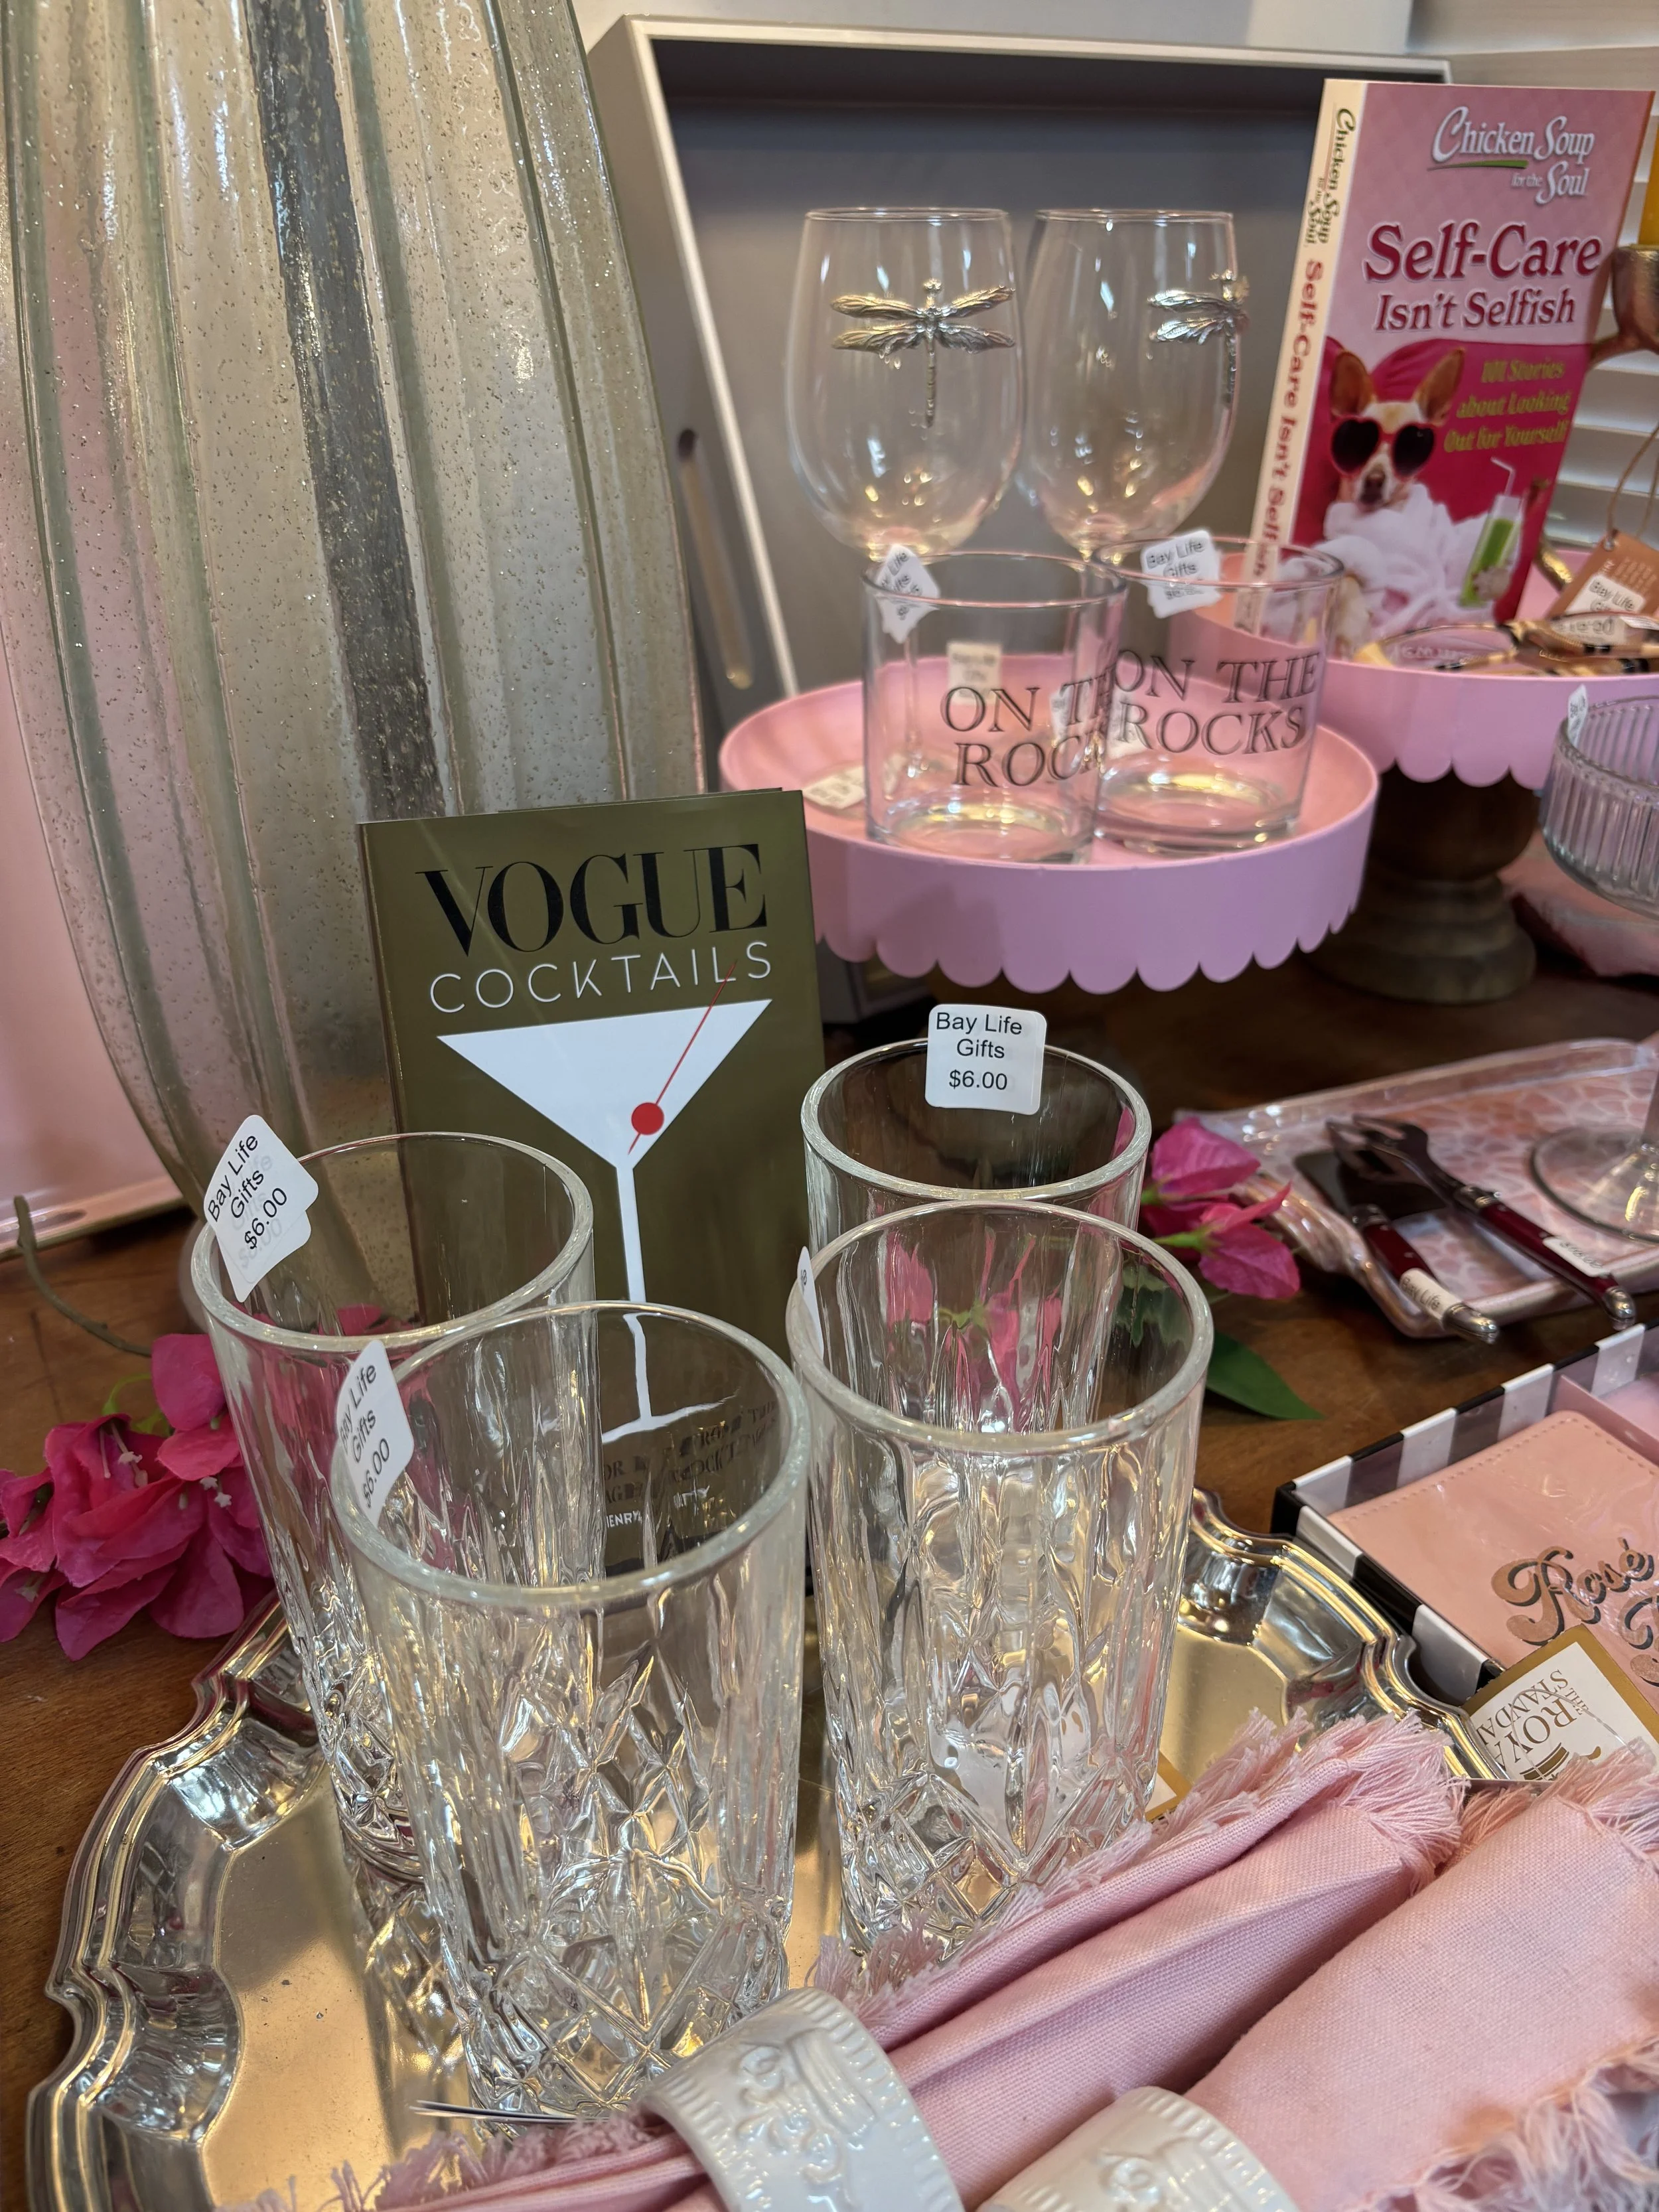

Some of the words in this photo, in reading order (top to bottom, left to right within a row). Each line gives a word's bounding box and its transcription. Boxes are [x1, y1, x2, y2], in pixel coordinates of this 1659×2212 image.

[1329, 108, 1356, 190] Chicken
[1432, 106, 1534, 162] Chicken
[1534, 115, 1595, 165] Soup
[1511, 173, 1526, 187] for
[1526, 173, 1543, 187] the
[1536, 161, 1590, 204] Soul
[1306, 201, 1321, 244] Soul
[1318, 192, 1340, 244] Soup
[1362, 220, 1602, 282] Self-Care
[1283, 259, 1323, 407] Self-Care
[1374, 290, 1457, 332] Isn't
[1462, 285, 1575, 328] Selfish
[1508, 357, 1565, 382] Stories
[1456, 394, 1506, 418] about
[1508, 390, 1571, 415] Looking
[1271, 415, 1296, 479] Isn't
[1444, 429, 1475, 453] Out
[1477, 425, 1502, 449] for
[1504, 419, 1570, 447] Yourself
[1145, 550, 1173, 569] Bay
[1175, 538, 1205, 558] Life
[1163, 561, 1197, 578] Gifts
[940, 686, 1041, 733] ON
[1060, 666, 1116, 726] TH
[1112, 649, 1192, 702] ON
[1216, 650, 1321, 705] THE
[1116, 701, 1305, 757] ROCKS
[415, 843, 767, 956] VOGUE
[430, 941, 771, 1013] COCKTAILS
[936, 1011, 977, 1035] Bay
[985, 1013, 1023, 1035] Life
[956, 1038, 1005, 1059] Gifts
[948, 1069, 1008, 1091] $6.00
[208, 1175, 232, 1222] Bay
[228, 1136, 258, 1176] Life
[231, 1170, 264, 1218] Gifts
[244, 1187, 287, 1250] $6.00
[349, 1364, 376, 1410] Life
[352, 1410, 376, 1463] Gifts
[363, 1438, 390, 1509] $6.00
[1491, 1537, 1654, 1647] Rosé
[1476, 1669, 1568, 1746] STANDA
[1565, 1688, 1590, 1715] THE
[1492, 1698, 1577, 1772] ROYA
